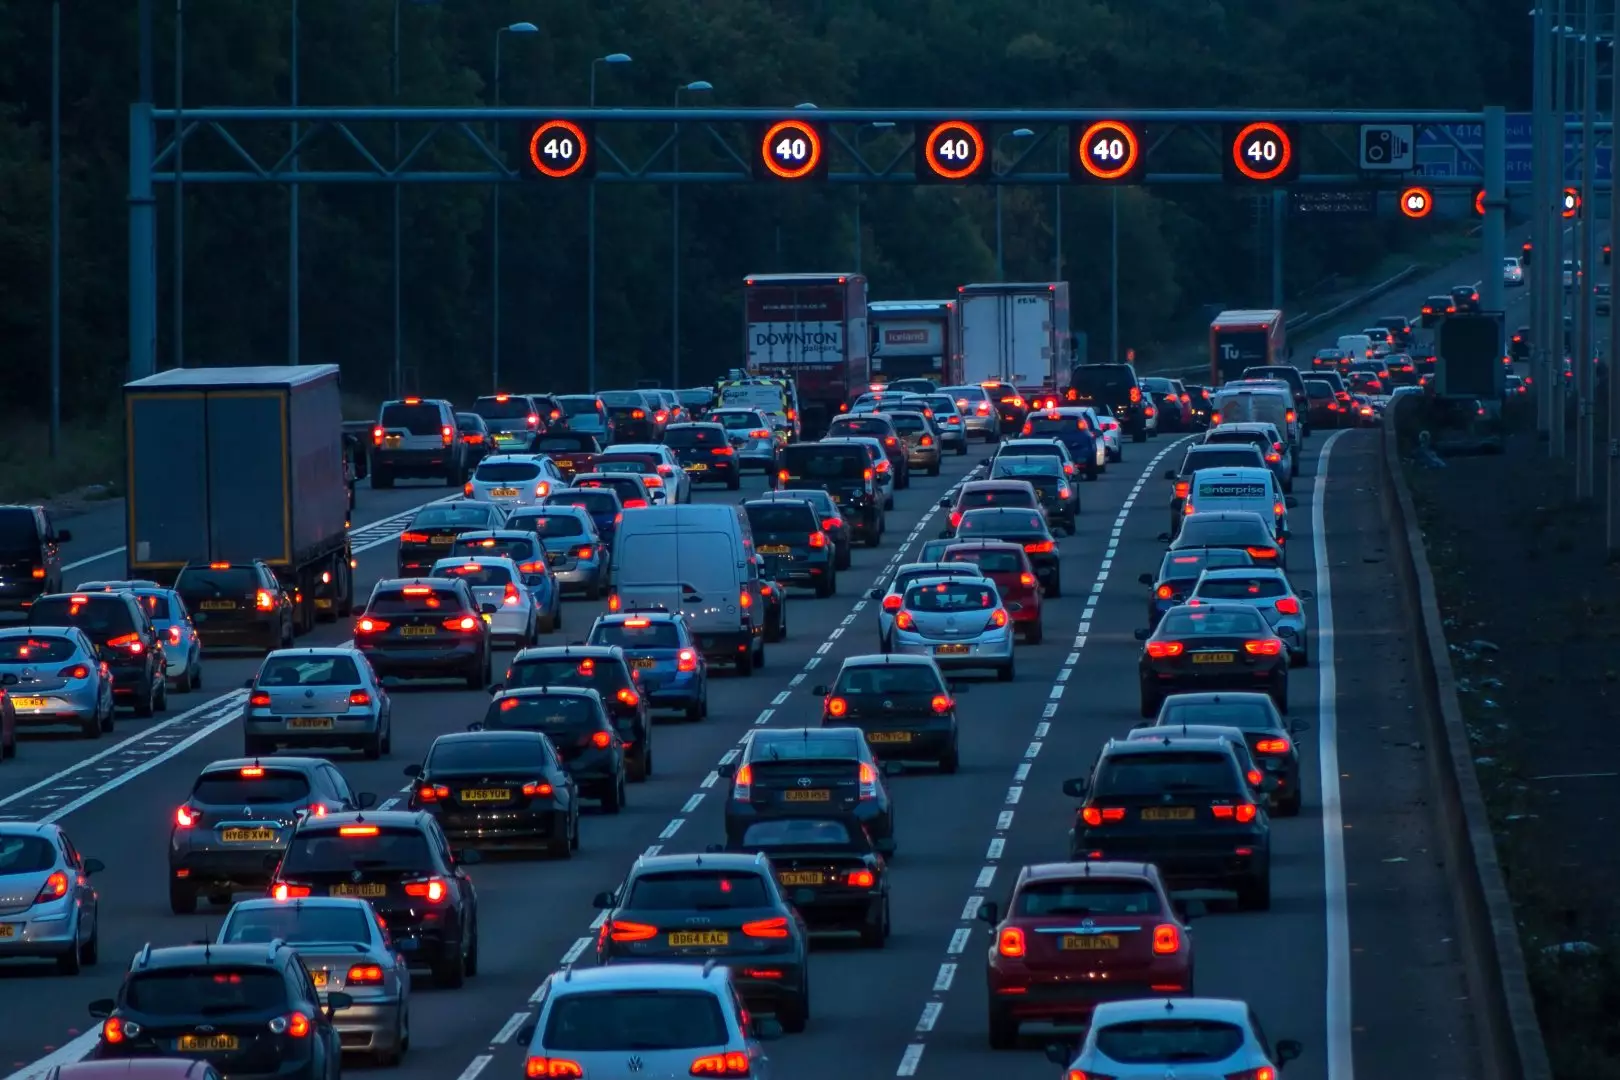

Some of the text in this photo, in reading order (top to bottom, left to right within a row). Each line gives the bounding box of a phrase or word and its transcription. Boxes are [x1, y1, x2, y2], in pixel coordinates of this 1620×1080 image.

[544, 139, 572, 158] 40
[777, 139, 805, 159] 40
[940, 140, 968, 159] 40
[1094, 140, 1123, 159] 40
[1248, 141, 1276, 160] 40
[756, 332, 837, 346] DOWNTON
[888, 332, 924, 342] Iceland
[1220, 344, 1240, 360] Tu
[0, 926, 13, 937] RC
[703, 933, 724, 944] EAC
